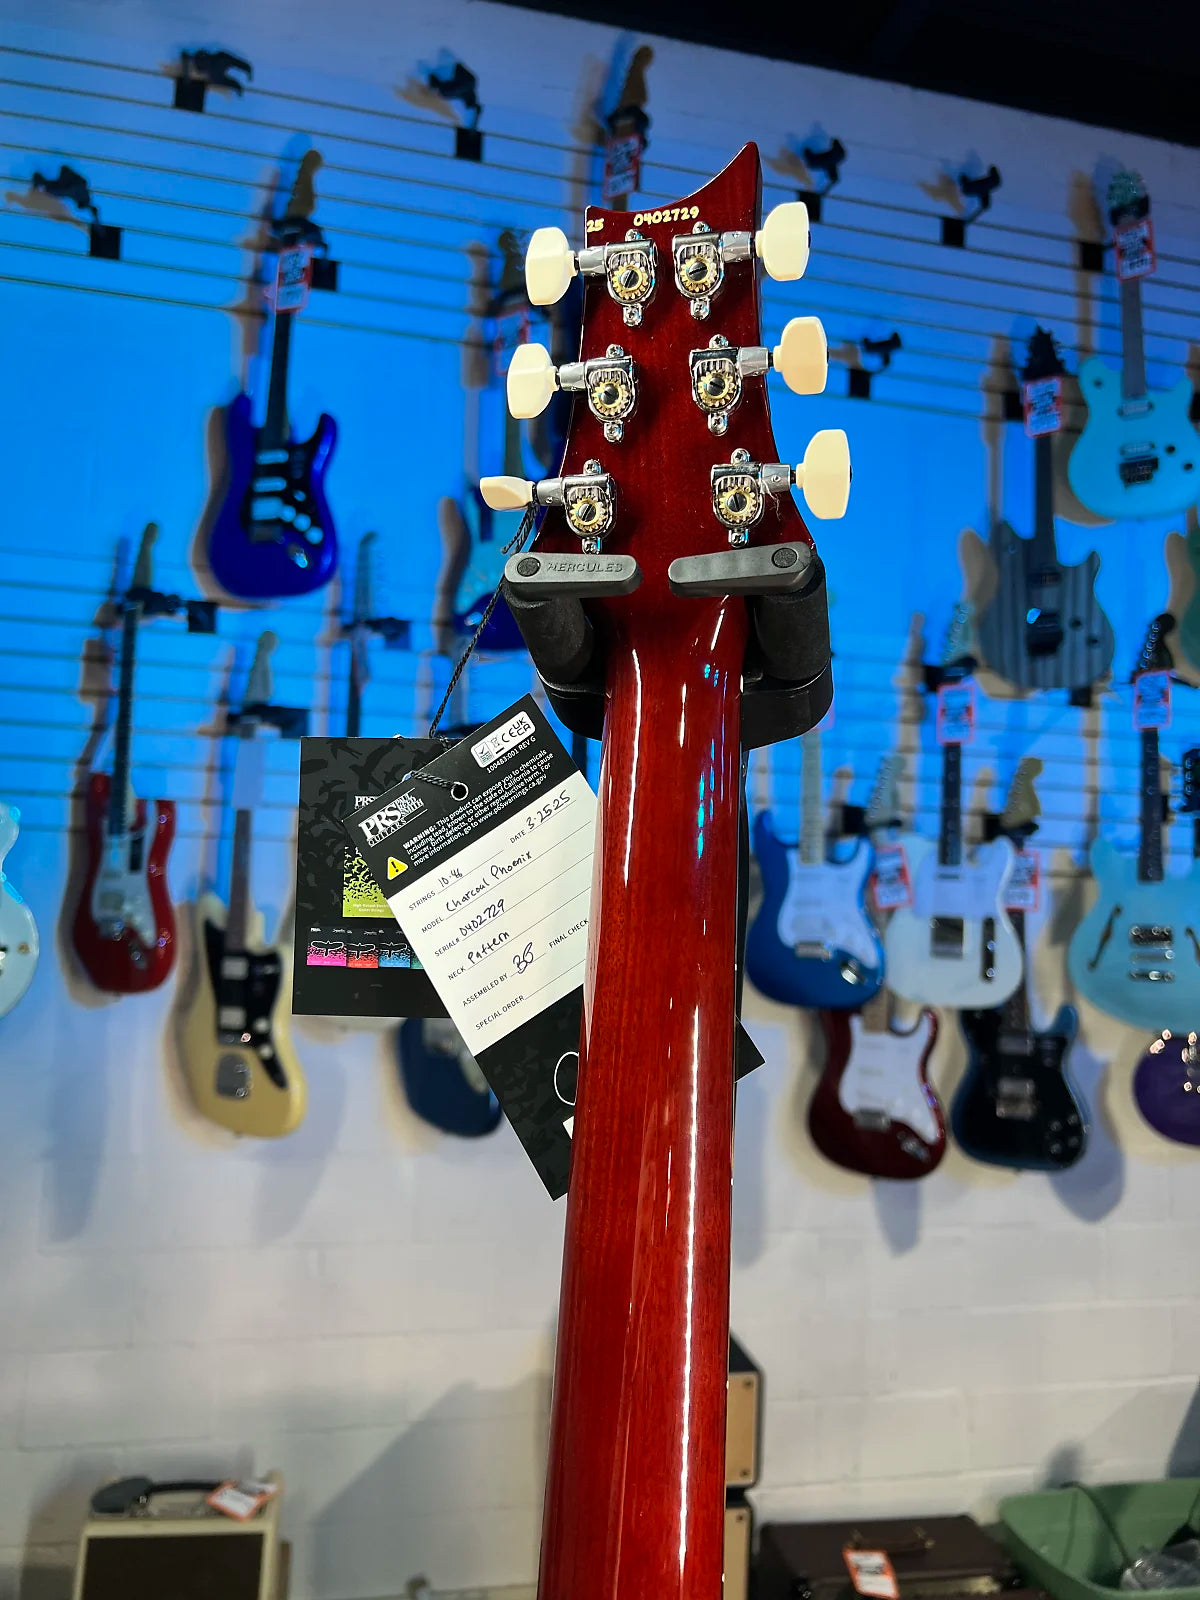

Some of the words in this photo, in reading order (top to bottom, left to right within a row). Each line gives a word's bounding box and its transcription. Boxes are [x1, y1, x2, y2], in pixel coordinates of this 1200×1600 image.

[586, 218, 604, 232] 25
[633, 206, 700, 226] 0402729
[547, 562, 623, 572] HERCULES
[518, 739, 530, 750] REV
[402, 824, 437, 849] WARNING:
[436, 816, 450, 827] This
[448, 801, 472, 820] product
[471, 794, 482, 804] can
[482, 781, 503, 798] expose
[501, 774, 514, 785] you
[519, 749, 547, 771] chemicals
[406, 834, 434, 855] including
[432, 825, 448, 837] lead,
[446, 812, 466, 828] known
[472, 801, 483, 810] the
[483, 792, 498, 804] state
[497, 786, 504, 794] of
[503, 769, 530, 790] California
[537, 753, 554, 767] cause
[410, 844, 432, 861] cancer,
[430, 834, 445, 847] birth
[444, 820, 468, 837] defects,
[474, 804, 490, 818] other
[489, 780, 525, 808] reproductive
[523, 770, 541, 783] harm.
[540, 762, 551, 772] For
[358, 803, 402, 842] PRS
[509, 829, 526, 843] DATE
[413, 853, 429, 866] more
[428, 830, 464, 856] information,
[463, 825, 472, 834] go
[445, 877, 490, 912] Charcoal
[490, 850, 532, 880] Phoenix
[408, 890, 436, 910] STRINGS
[421, 916, 444, 933] MODEL
[459, 898, 506, 937] 0402729
[548, 933, 567, 948] FINAL
[567, 918, 589, 935] CHECK
[434, 937, 460, 956] SERIAL#
[448, 966, 466, 980] NECK
[462, 979, 499, 1006] ASSEMBLED
[499, 972, 508, 982] BY
[475, 1010, 502, 1030] SPECIAL
[502, 995, 525, 1012] ORDER
